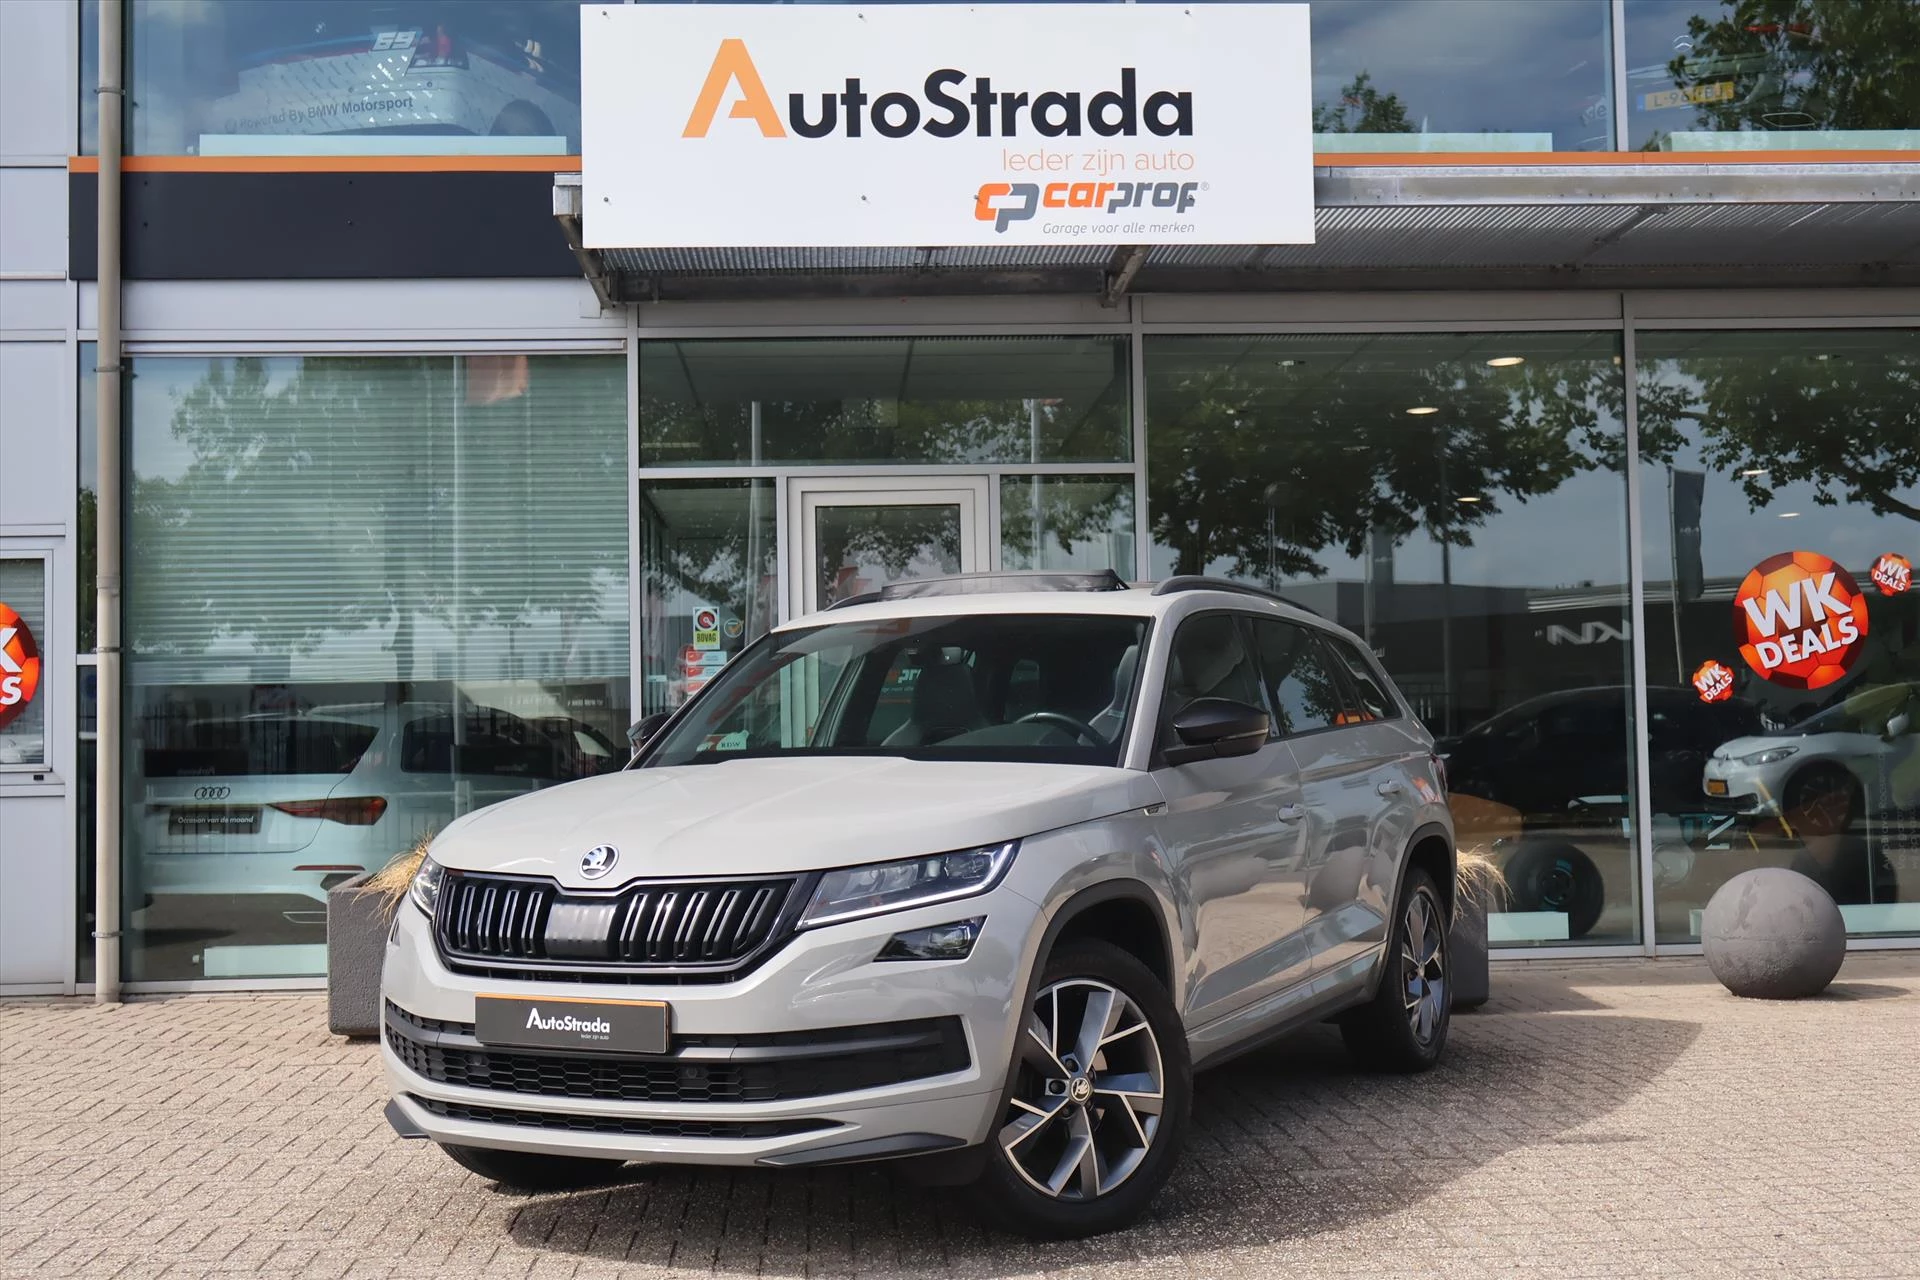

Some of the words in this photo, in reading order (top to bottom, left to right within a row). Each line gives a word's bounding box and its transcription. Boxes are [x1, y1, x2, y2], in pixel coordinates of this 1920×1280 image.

[372, 31, 416, 50] 69
[682, 38, 1194, 139] AutoStrada
[240, 112, 285, 129] Powered
[289, 109, 304, 123] By
[307, 103, 339, 119] BMW
[342, 97, 414, 113] Motorsport
[1002, 148, 1073, 172] Ieder
[1082, 149, 1125, 177] zijn
[1135, 149, 1195, 172] auto
[1043, 223, 1087, 237] Garage
[1091, 224, 1119, 234] voor
[1123, 222, 1145, 234] alle
[1149, 222, 1195, 234] merken
[1873, 572, 1906, 592] DEALS
[1879, 557, 1910, 582] WK
[1742, 572, 1852, 638] WK
[696, 632, 717, 643] BOVAG
[1755, 616, 1859, 670] DEALS
[1695, 663, 1727, 692] WK
[1704, 673, 1733, 701] DEALS
[526, 1008, 610, 1033] AutoStrada
